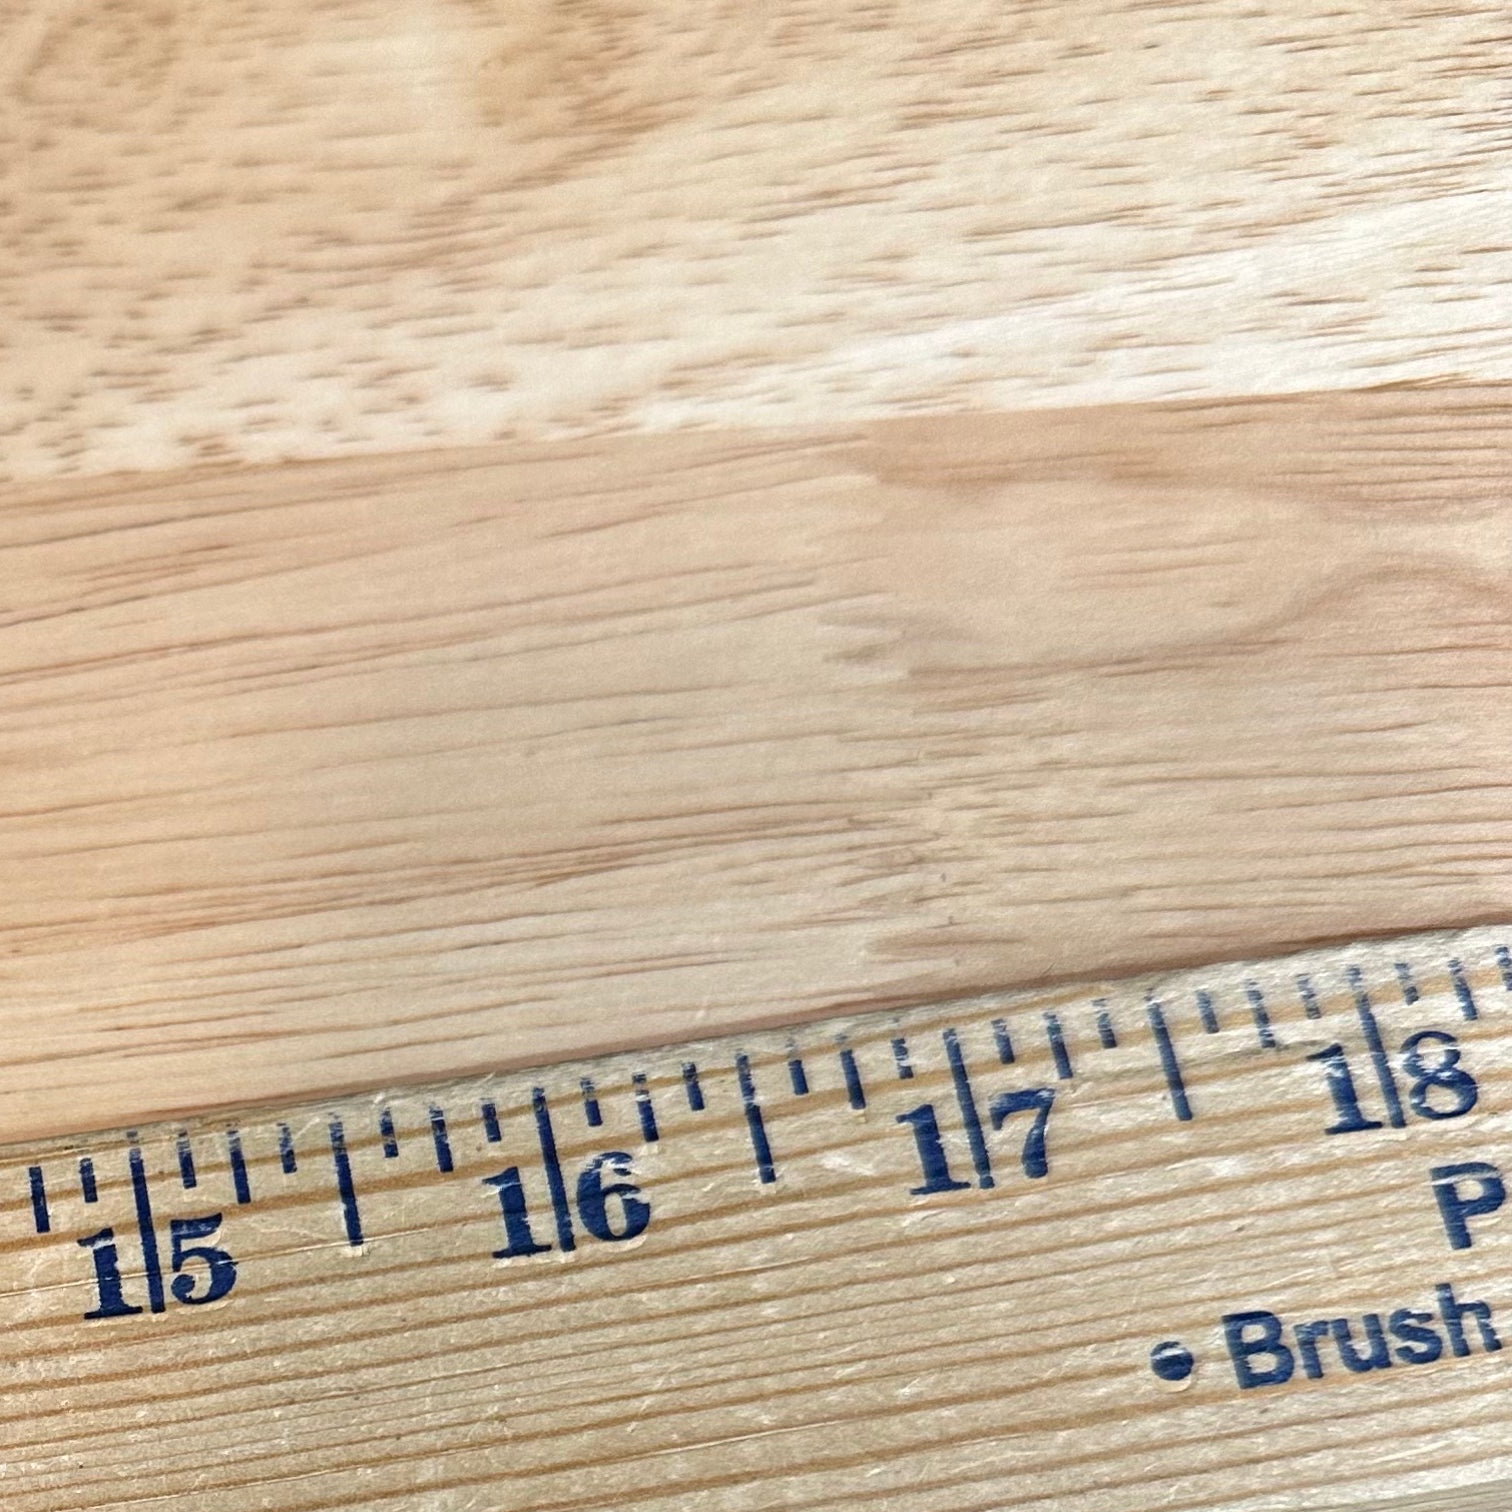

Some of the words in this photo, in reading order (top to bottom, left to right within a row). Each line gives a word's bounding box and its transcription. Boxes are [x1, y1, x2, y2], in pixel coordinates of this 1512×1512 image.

[76, 1211, 238, 1320] 15
[481, 1150, 652, 1260] 16
[895, 1086, 1057, 1196] 17
[1305, 1029, 1480, 1136] 18
[1220, 1281, 1504, 1390] Brush
